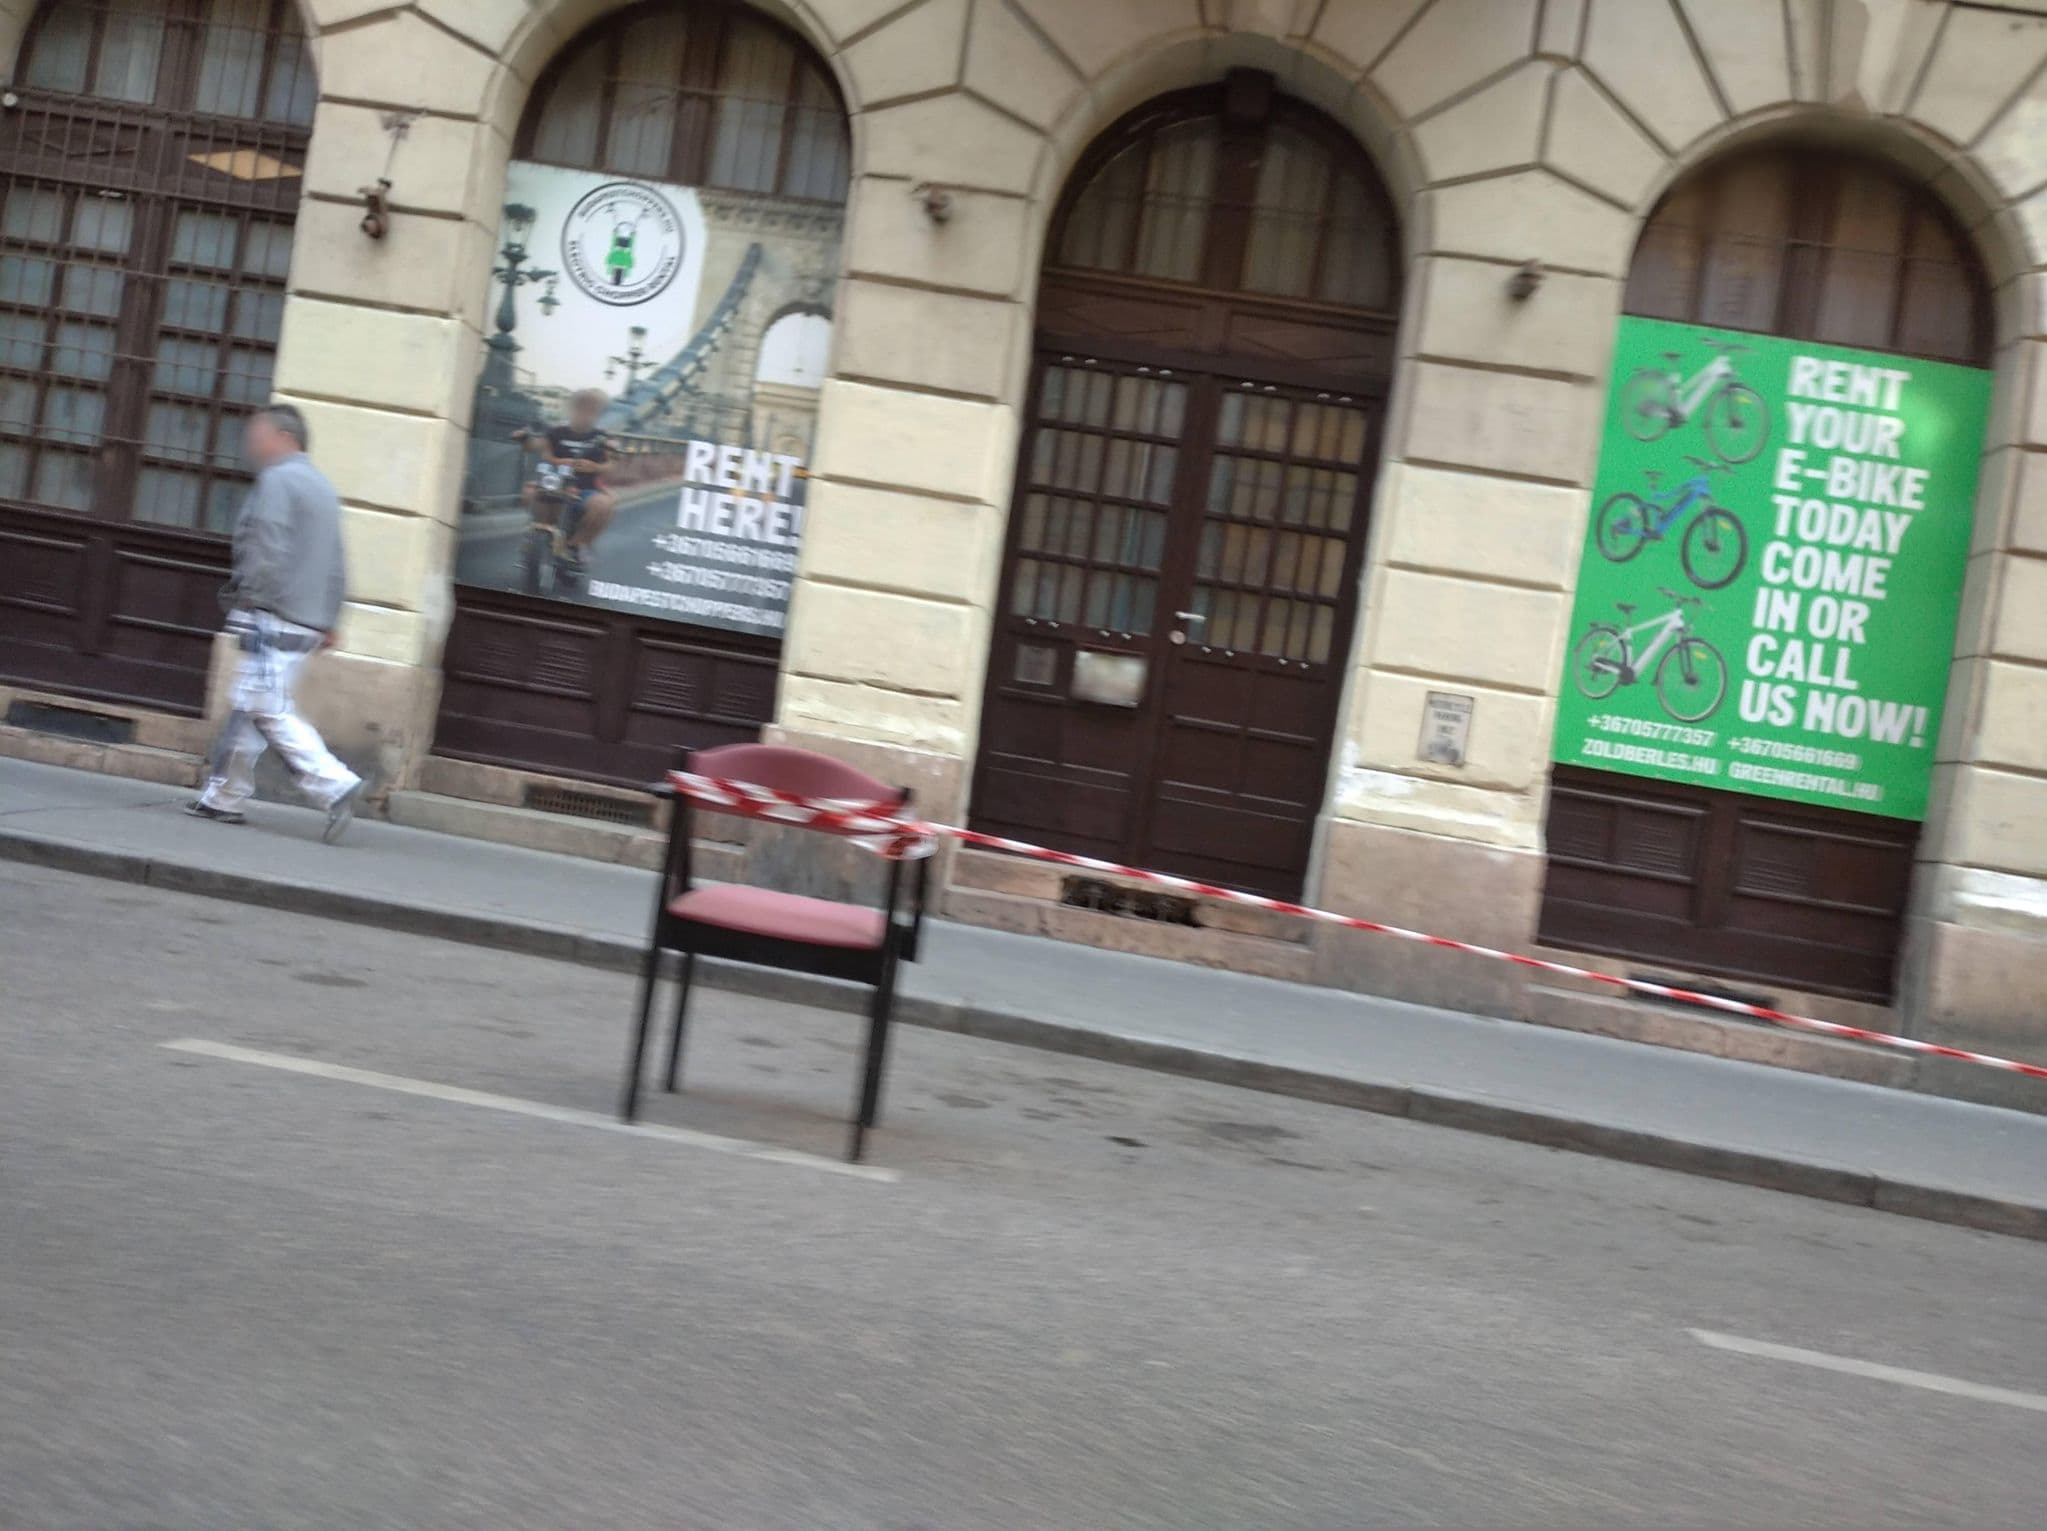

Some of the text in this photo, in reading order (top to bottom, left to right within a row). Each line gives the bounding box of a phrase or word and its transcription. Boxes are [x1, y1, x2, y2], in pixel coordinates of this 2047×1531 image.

[1788, 356, 1911, 411] RENT
[1784, 402, 1905, 459] YOUR
[684, 440, 801, 498] RENT
[1774, 448, 1930, 510] E-BIKE
[677, 488, 805, 548] HERE!
[1770, 495, 1912, 553] TODAY
[1761, 542, 1891, 599] COME
[1752, 588, 1871, 644] IN OR
[1746, 638, 1858, 690] CALL
[1740, 681, 1930, 748] US NOW!
